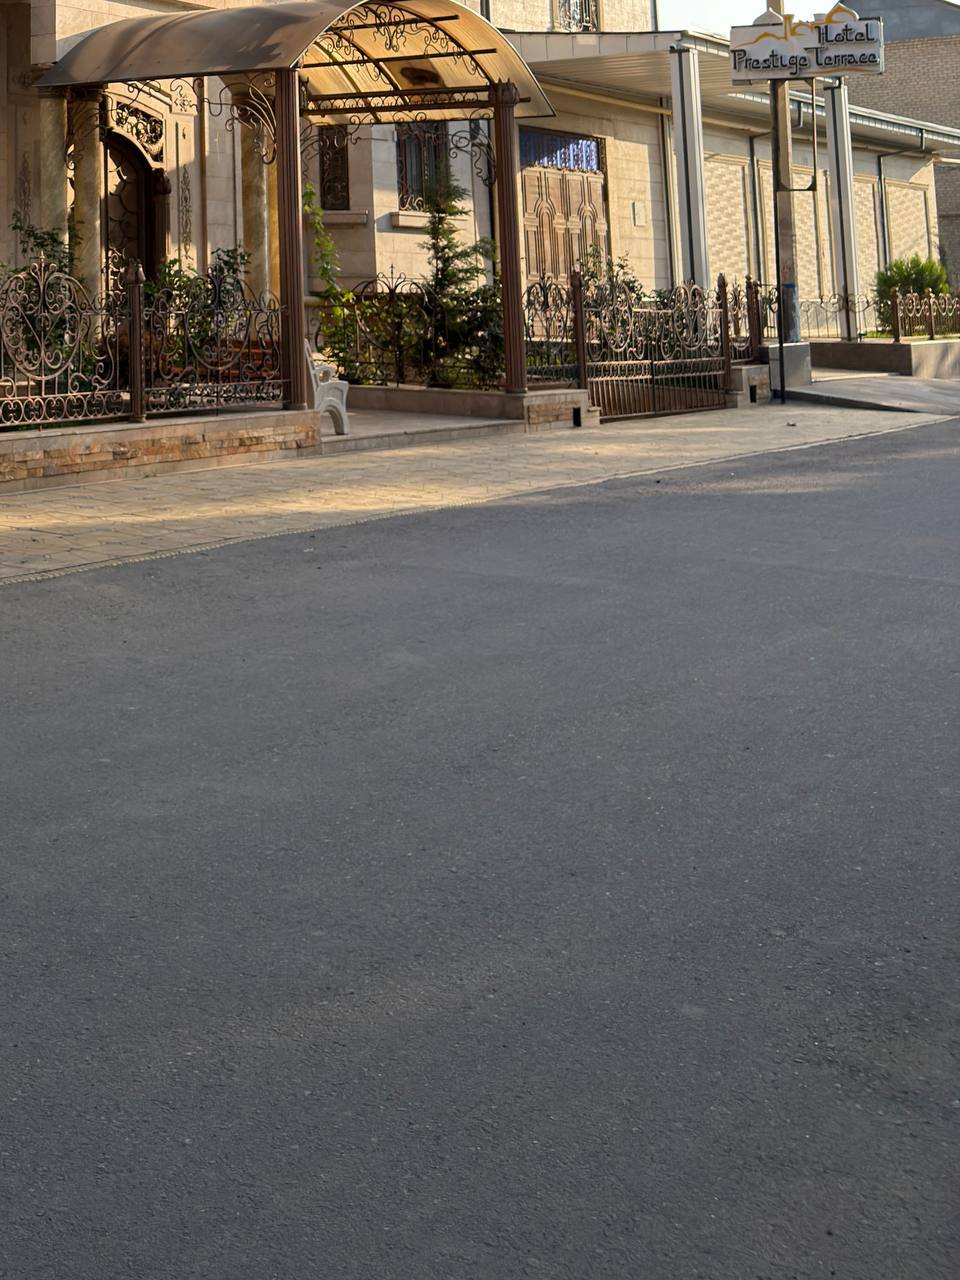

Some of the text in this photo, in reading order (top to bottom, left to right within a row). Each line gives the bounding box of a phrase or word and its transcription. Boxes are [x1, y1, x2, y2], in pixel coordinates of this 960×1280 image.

[814, 23, 875, 43] Hotel
[730, 47, 878, 75] Prestige Terrace
